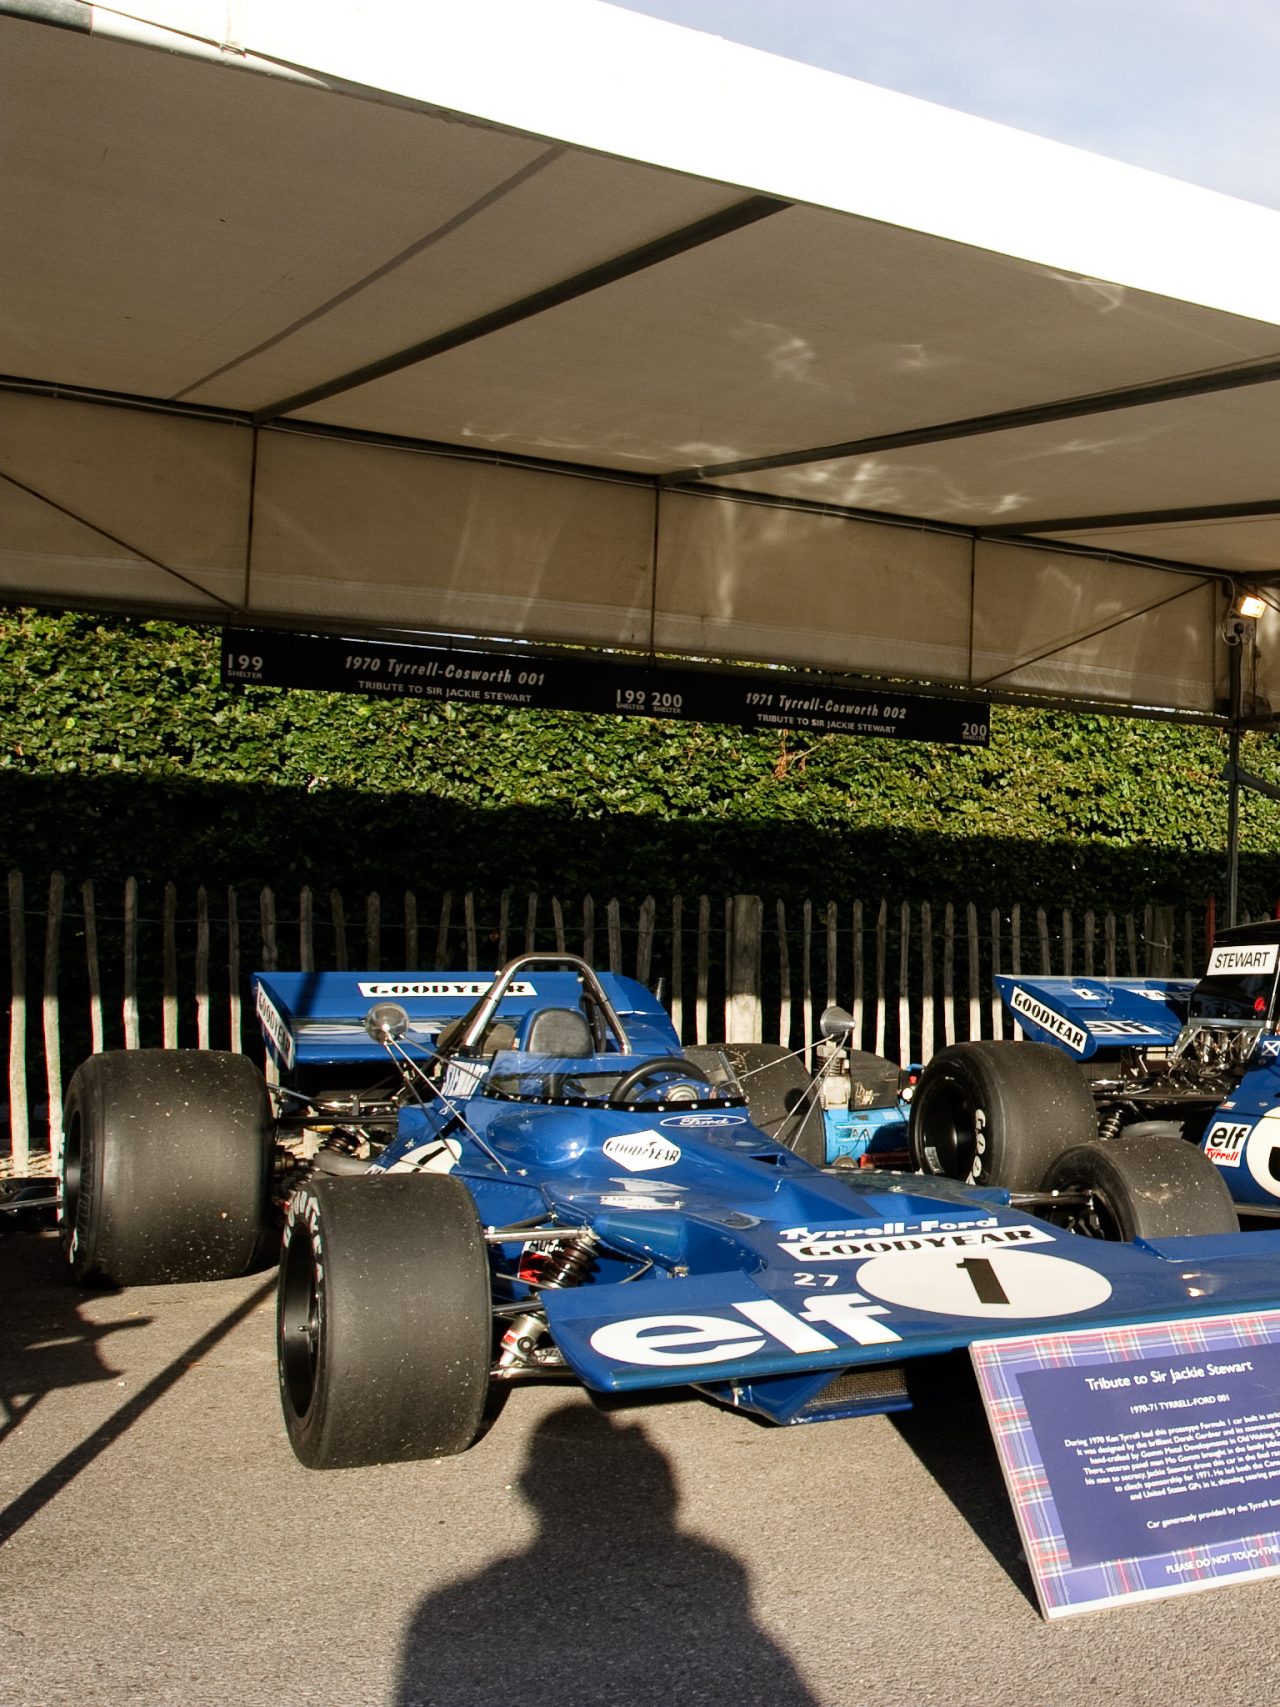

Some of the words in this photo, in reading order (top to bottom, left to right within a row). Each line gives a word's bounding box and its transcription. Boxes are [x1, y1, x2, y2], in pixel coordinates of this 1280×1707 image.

[228, 654, 263, 671] 199
[346, 656, 380, 671] 1970
[388, 658, 511, 684] Tyrrell-Cosworth
[518, 672, 545, 686] 001
[227, 670, 262, 679] SHELTER
[358, 680, 404, 693] TRIBUTE
[408, 684, 422, 693] TO
[426, 686, 442, 695] SIR
[446, 688, 481, 699] JACKIE
[484, 691, 532, 702] STEWART
[616, 689, 646, 704] 199
[651, 692, 683, 708] 200
[616, 703, 645, 711] SHELTER
[653, 706, 681, 714] SHELTER
[745, 692, 773, 706] 1971
[779, 694, 878, 717] Tyrrell-Cosworth
[883, 706, 907, 719] 002
[757, 713, 794, 724] TRIBUTE
[796, 717, 809, 726] TO
[811, 719, 825, 727] SIR
[827, 720, 855, 731] JACKIE
[857, 723, 896, 734] STEWART
[962, 723, 987, 737] 200
[1215, 951, 1270, 969] STEWART
[369, 985, 525, 994] GOODYER
[1014, 992, 1084, 1047] GOODYEAR
[680, 1117, 730, 1126] Ford
[1211, 1127, 1247, 1149] elf
[605, 1141, 679, 1162] GOODYEAR
[1206, 1148, 1239, 1161] Tyrrell
[779, 1218, 998, 1242] Tyrrell-Ford
[799, 1230, 1035, 1256] GOODYEAR
[793, 1272, 839, 1287] 27
[956, 1257, 1010, 1304] 1
[590, 1293, 903, 1366] elf
[1085, 1376, 1131, 1391] Tribute
[1134, 1375, 1148, 1385] to
[1150, 1370, 1168, 1384] Sir
[1170, 1366, 1205, 1384] Jackie
[1206, 1361, 1253, 1376] Stewart
[1130, 1402, 1158, 1414] 1970-71
[1159, 1395, 1216, 1411] TYRRELL-FORD
[1217, 1394, 1230, 1402] 001
[1064, 1439, 1088, 1448] During
[1089, 1436, 1104, 1445] 1970
[1106, 1435, 1119, 1443] Ken
[1118, 1432, 1140, 1442] Tyrrell
[1126, 1443, 1135, 1451] by
[1147, 1520, 1160, 1529] Car
[1162, 1513, 1197, 1529] generously
[1198, 1508, 1227, 1521] provided
[1227, 1506, 1236, 1516] by
[1237, 1504, 1248, 1513] the
[1248, 1501, 1269, 1512] Tyrrell
[1165, 1561, 1194, 1574] PLEASE
[1196, 1559, 1211, 1568] DO
[1211, 1555, 1231, 1565] NOT
[1231, 1548, 1263, 1562] TOUCH
[1263, 1545, 1279, 1555] THE
